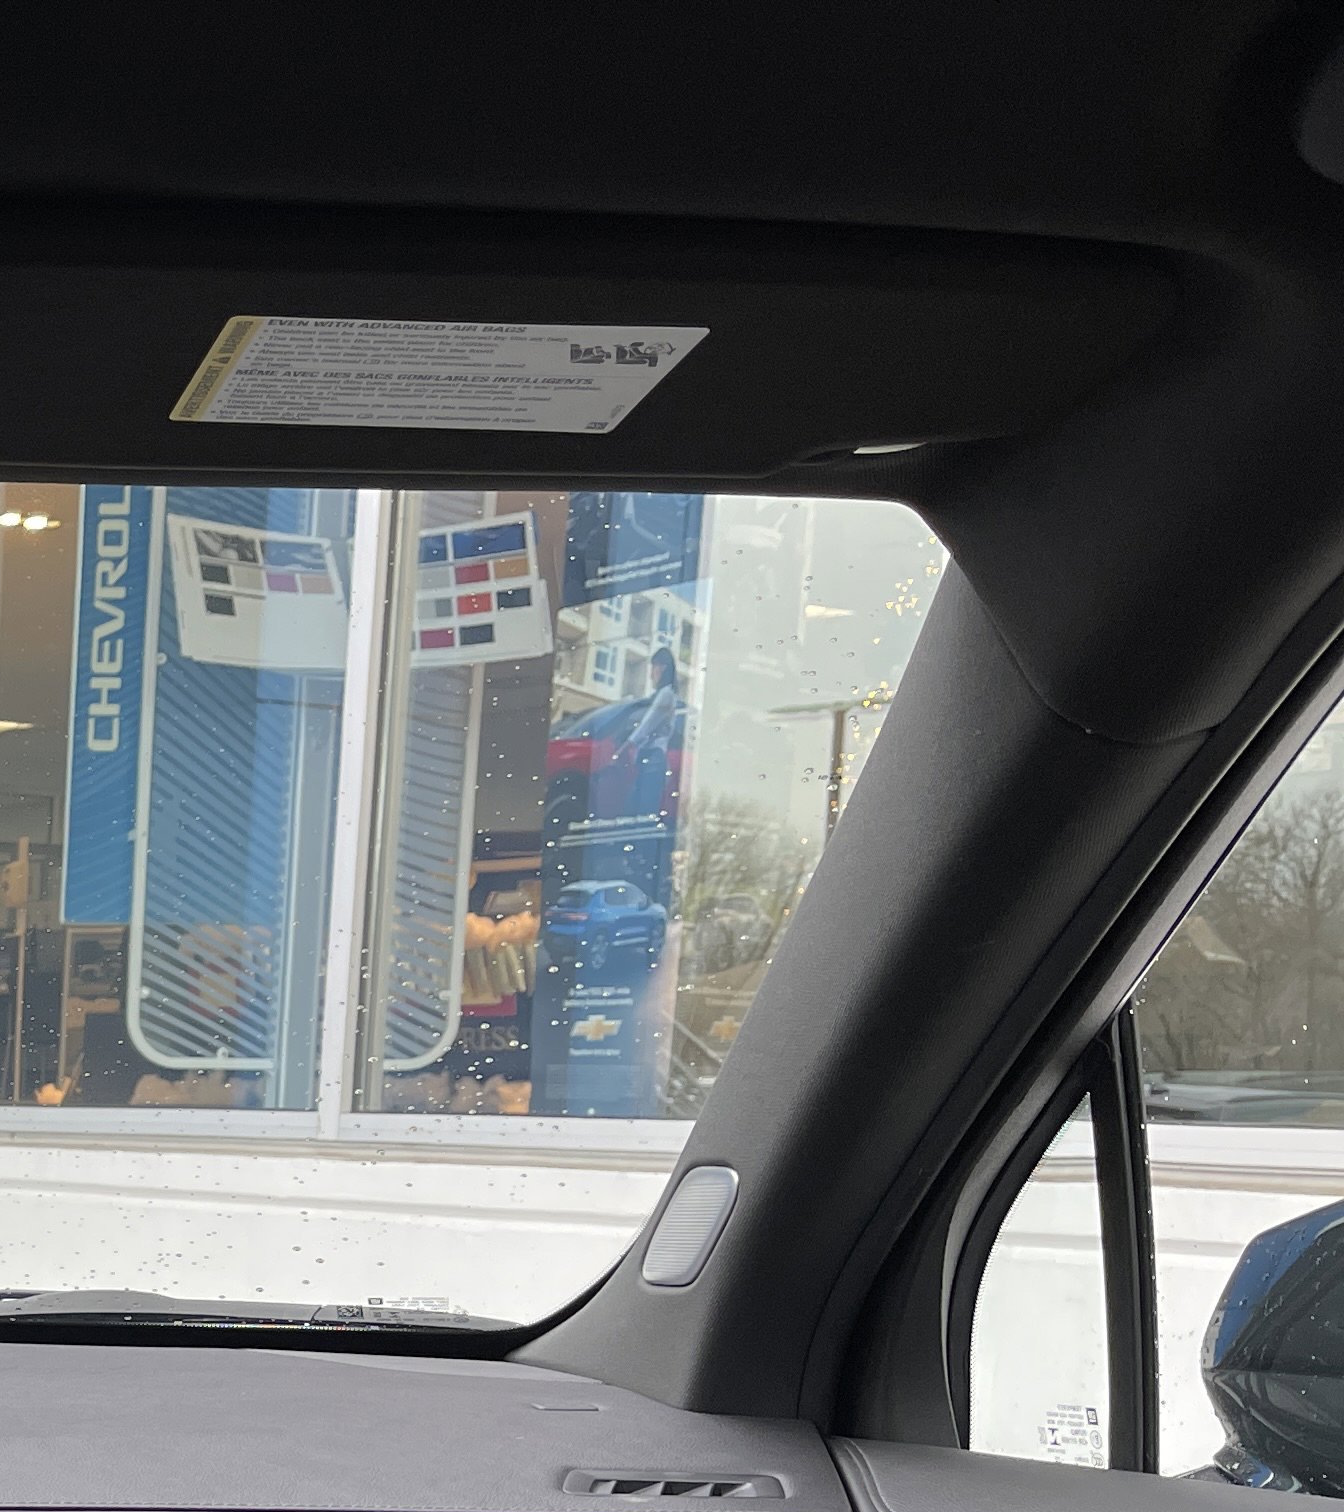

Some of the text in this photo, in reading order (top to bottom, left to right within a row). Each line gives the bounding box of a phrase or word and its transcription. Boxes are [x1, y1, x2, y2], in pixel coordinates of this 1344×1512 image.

[267, 319, 528, 334] EVEN WITH ADVANCED AIR BAGS
[281, 370, 320, 378] AVEC
[354, 372, 395, 380] SACS
